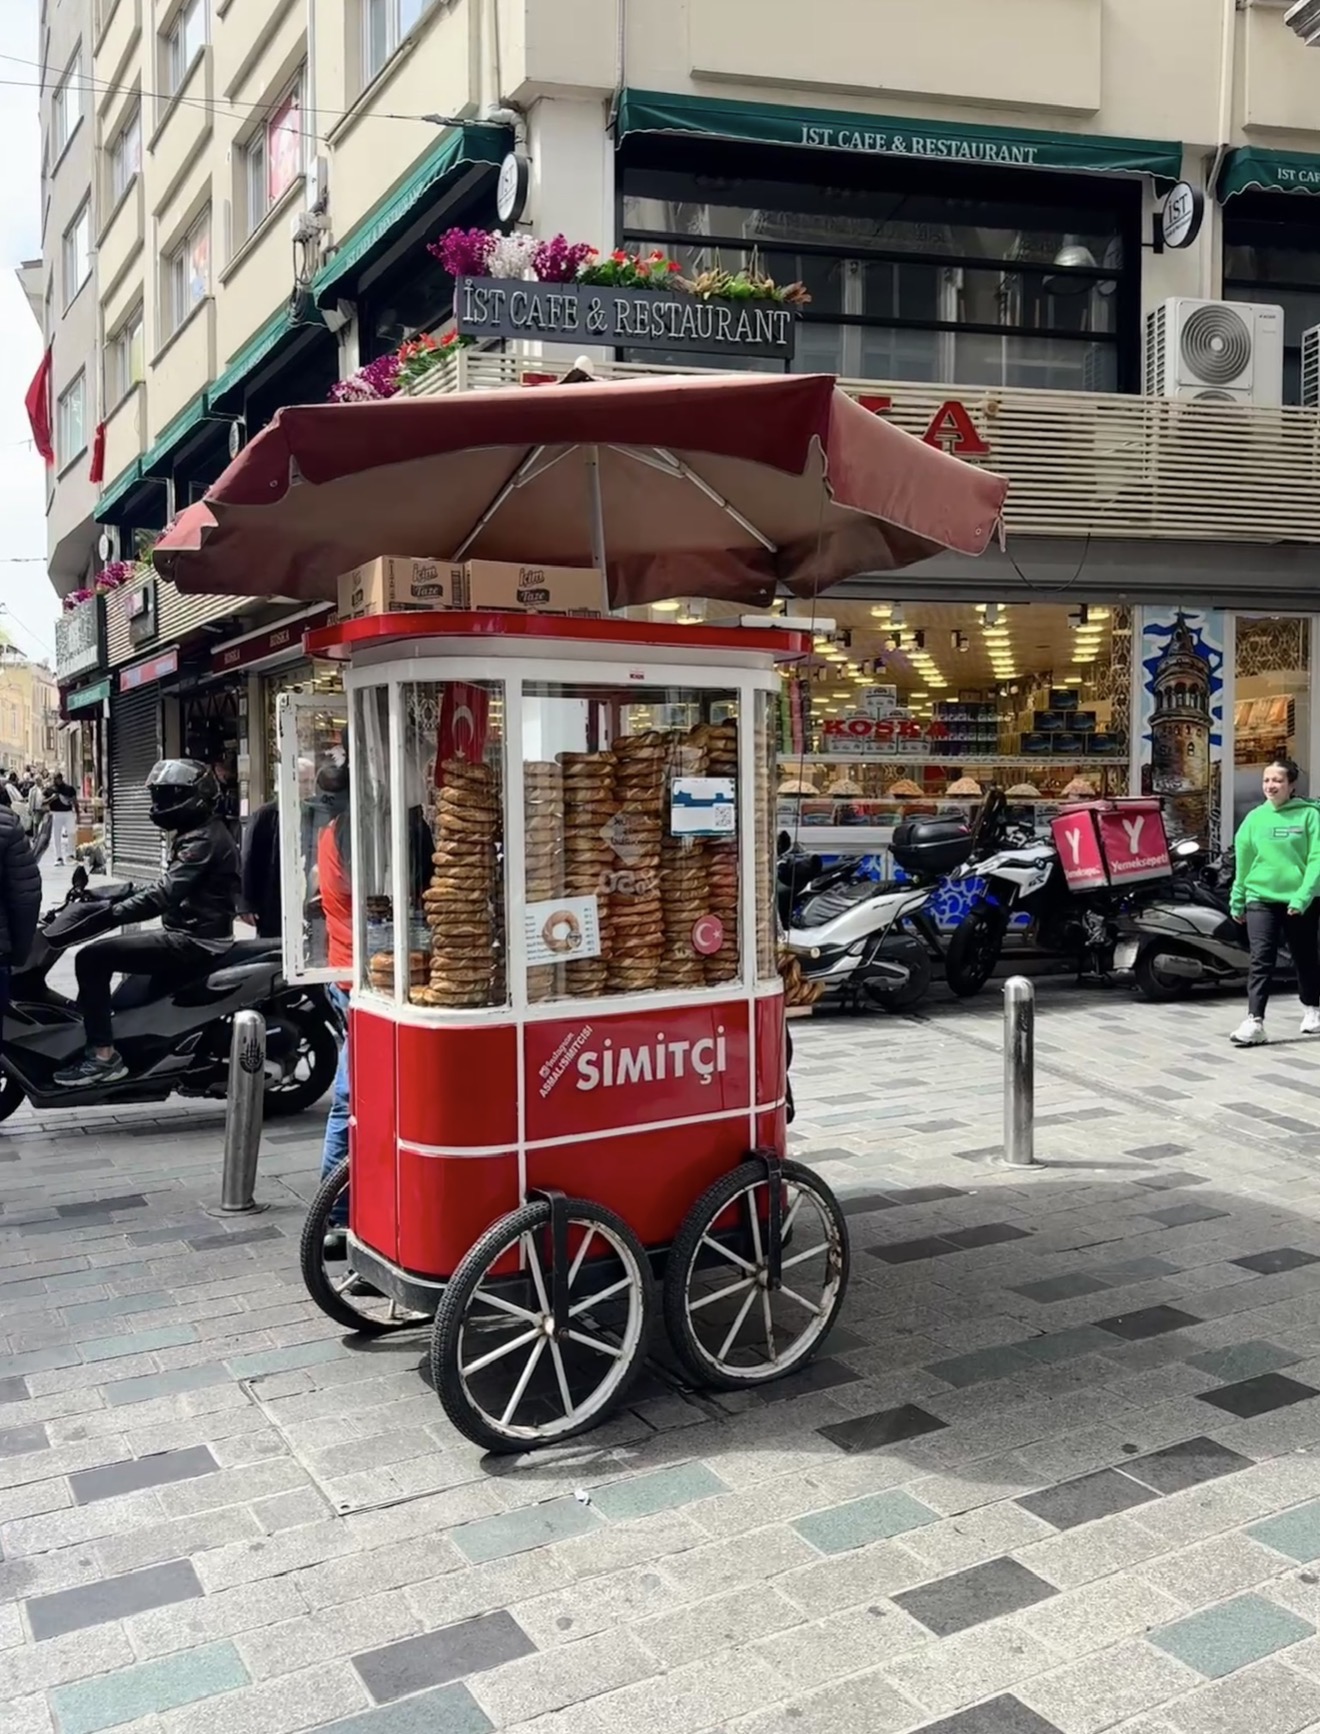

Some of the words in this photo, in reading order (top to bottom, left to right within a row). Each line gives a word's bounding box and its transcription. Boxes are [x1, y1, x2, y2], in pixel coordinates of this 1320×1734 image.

[838, 130, 886, 151] CAFE
[891, 135, 907, 154] &
[911, 136, 1038, 164] RESTAURANT
[462, 278, 506, 323] İST
[510, 290, 579, 329] CAFE
[586, 297, 608, 331] &
[614, 298, 791, 345] RESTAURANT
[822, 719, 949, 738] KOSKA
[576, 1025, 727, 1091] SİMİTÇİ
